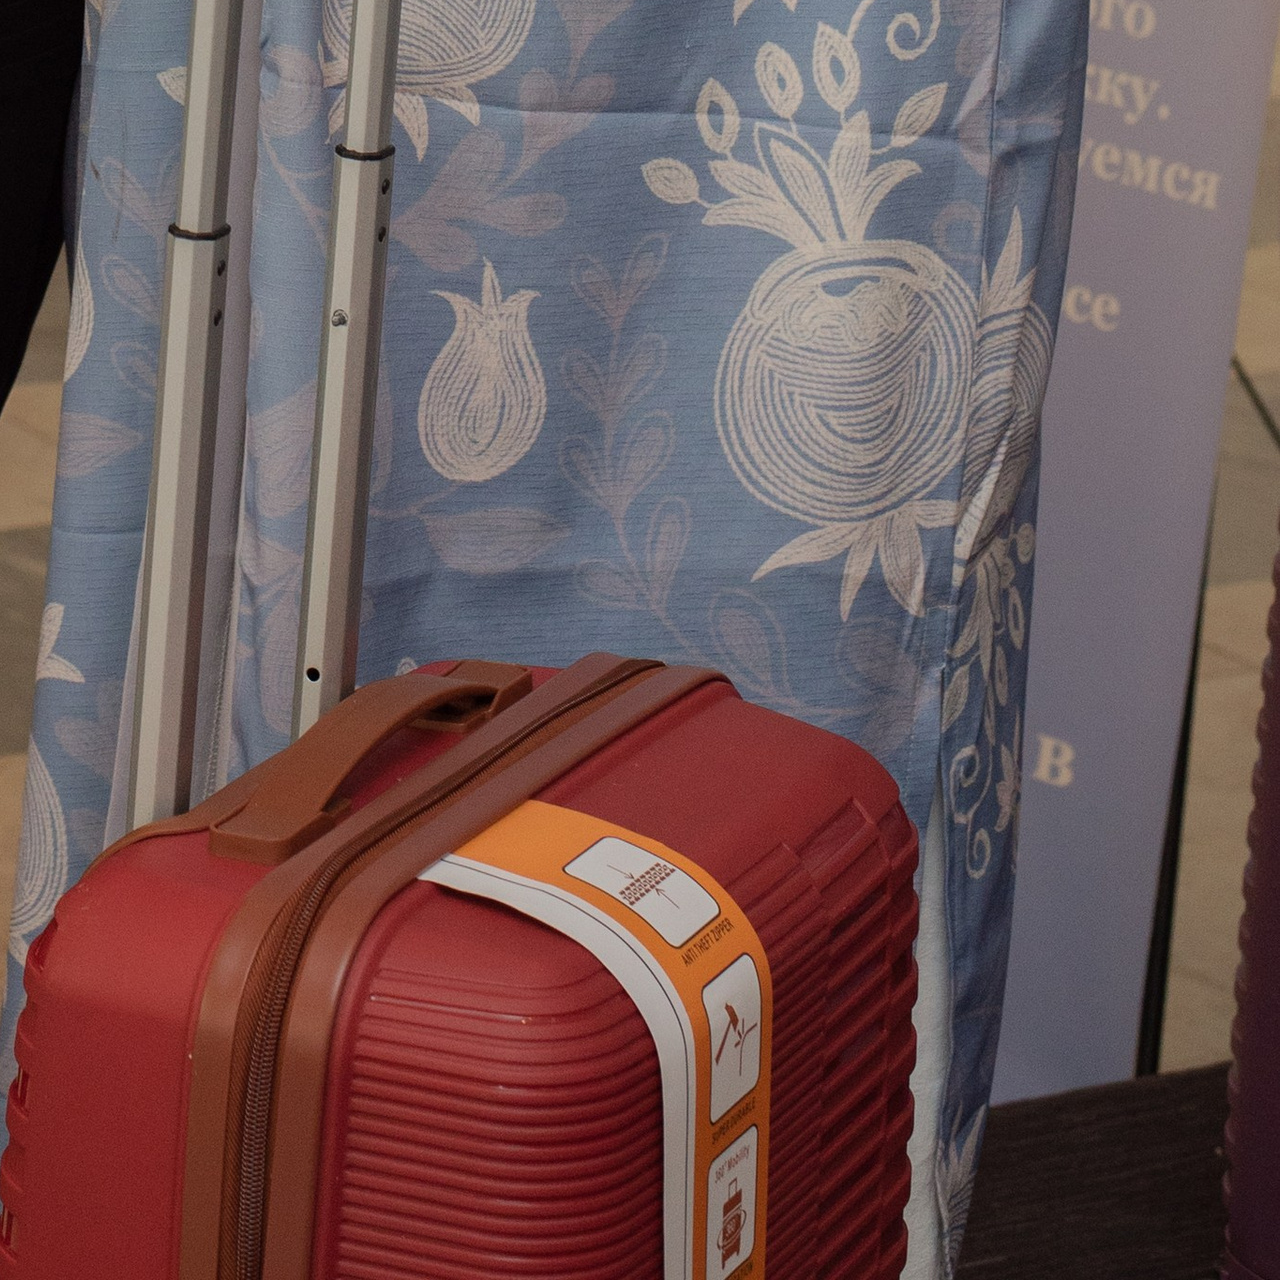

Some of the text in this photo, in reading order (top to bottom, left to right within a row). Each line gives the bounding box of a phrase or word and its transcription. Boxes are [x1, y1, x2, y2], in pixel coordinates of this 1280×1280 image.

[681, 917, 735, 967] ANTI THEFT ZIPPER
